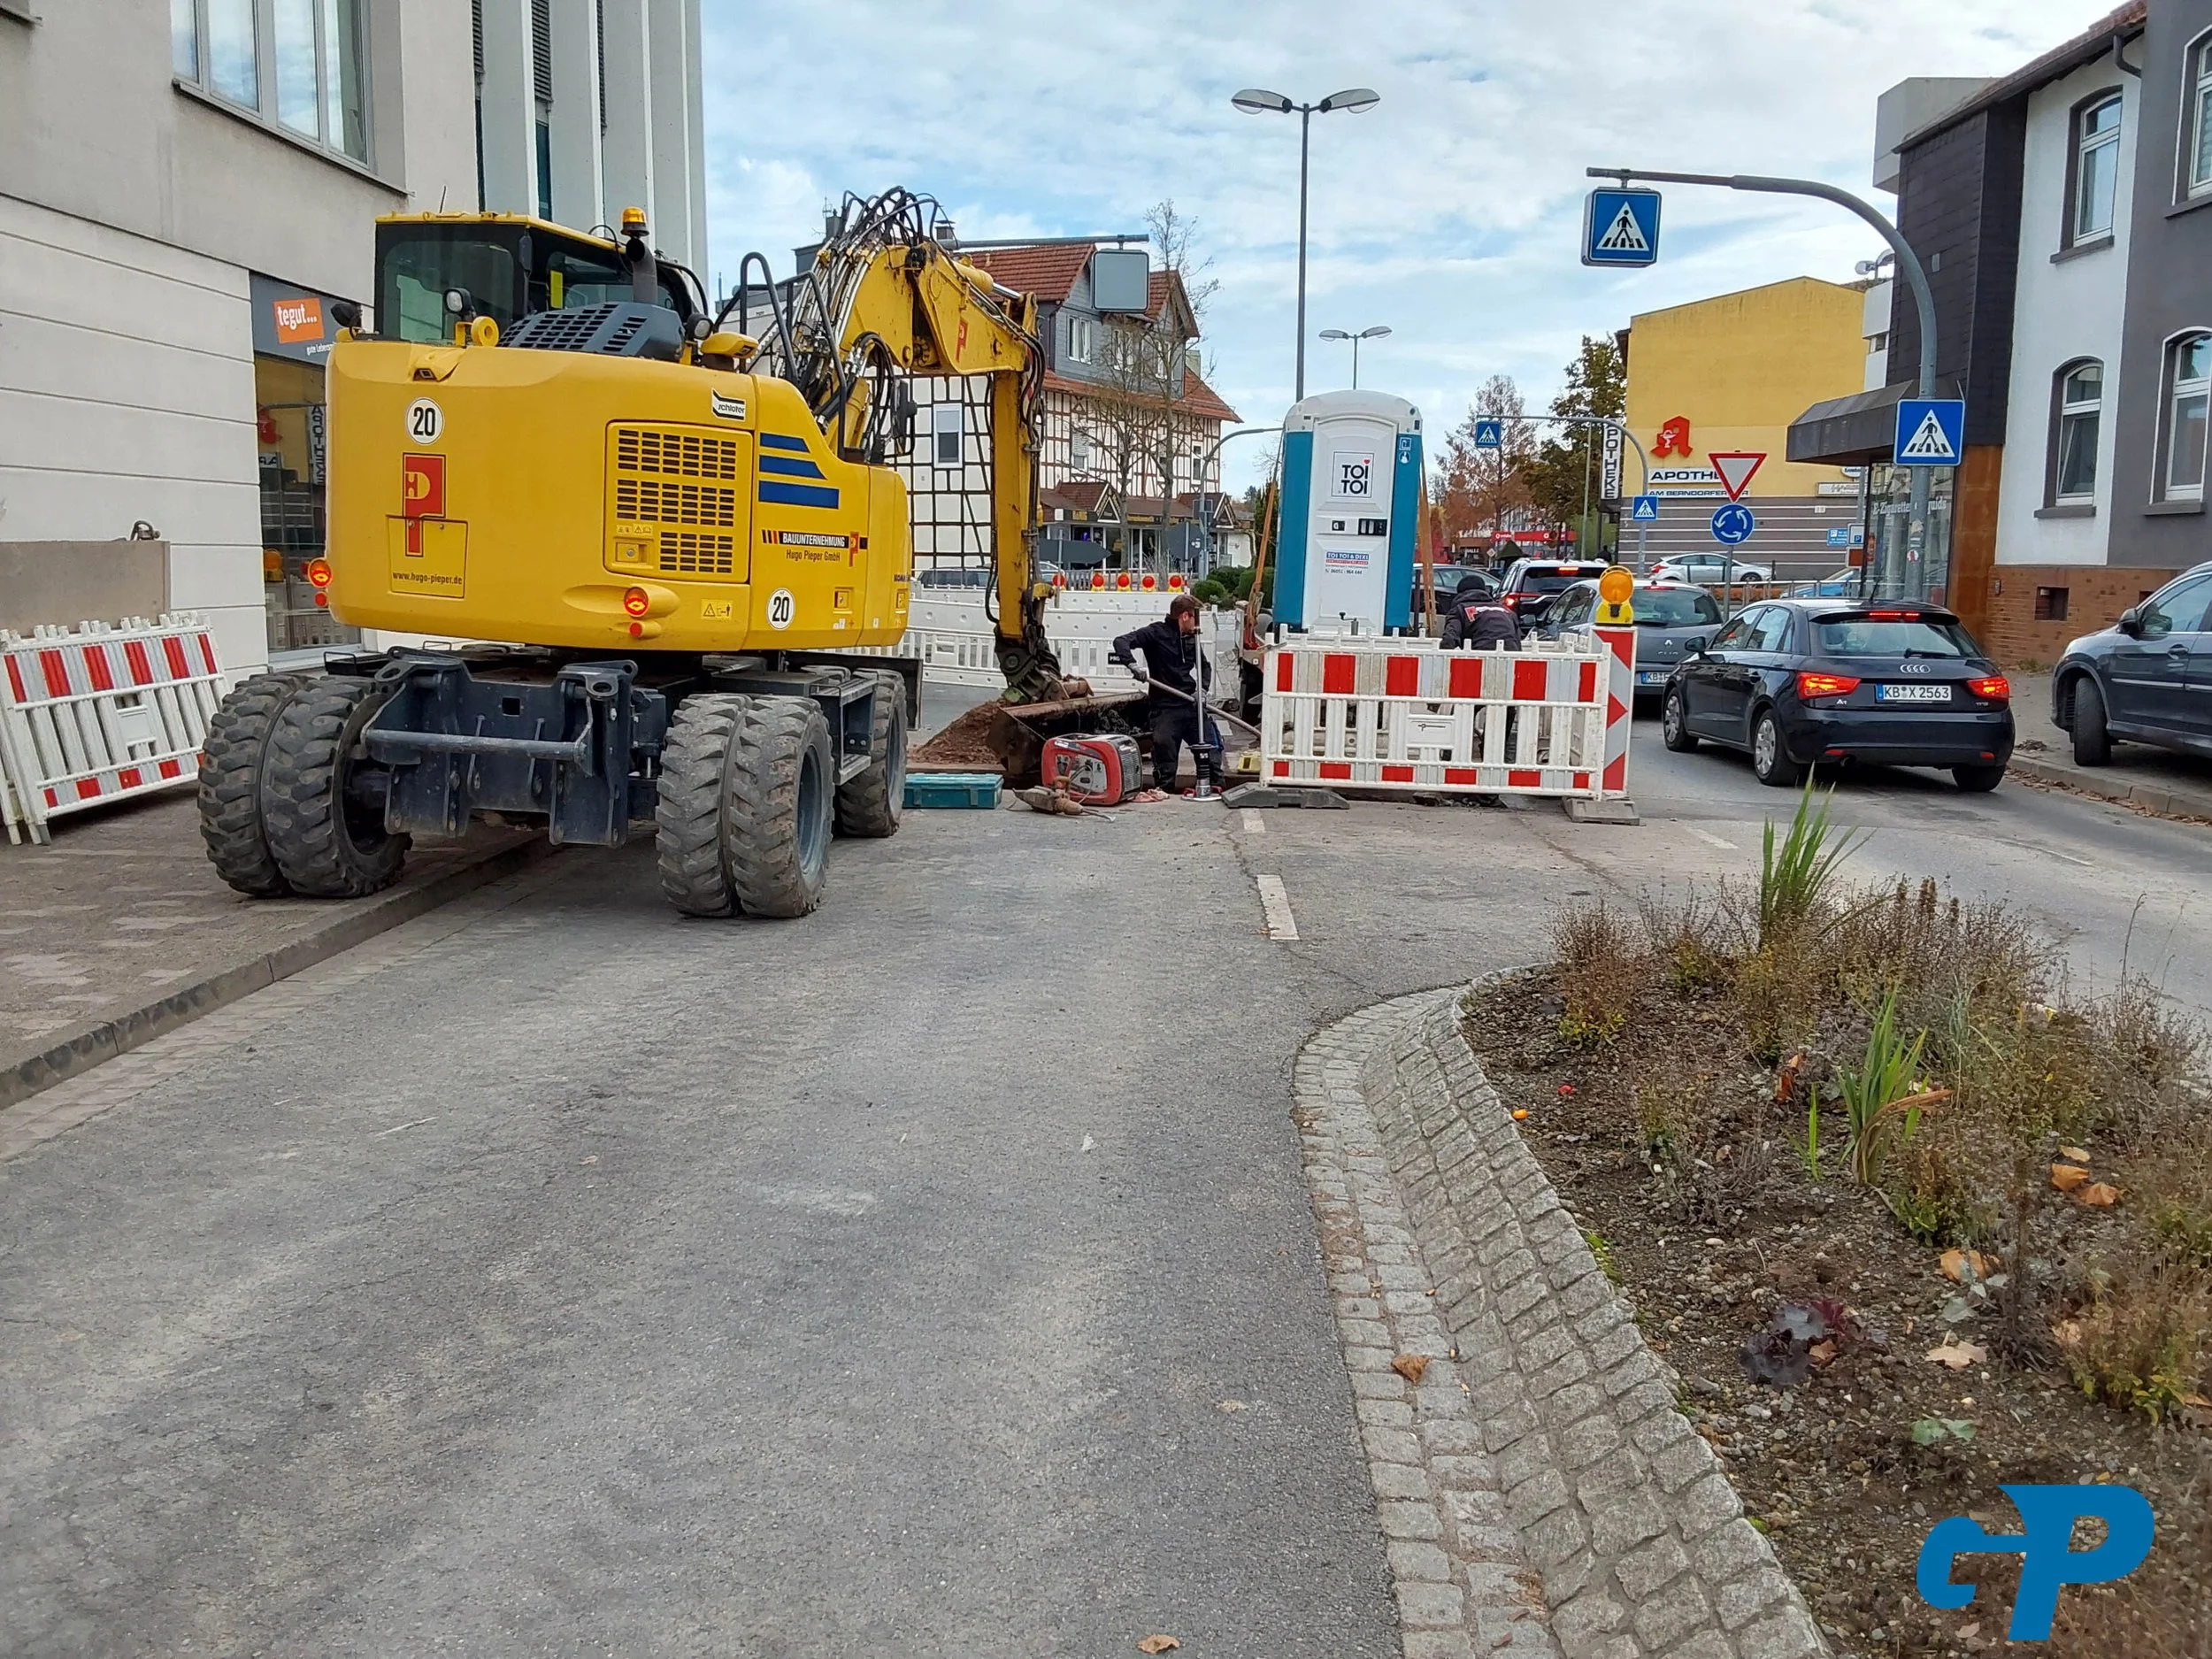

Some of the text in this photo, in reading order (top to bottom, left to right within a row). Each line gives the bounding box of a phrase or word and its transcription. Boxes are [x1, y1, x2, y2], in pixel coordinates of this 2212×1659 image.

[413, 407, 435, 436] 20
[1342, 465, 1369, 479] TOI
[1650, 471, 1719, 480] APOTH
[1341, 480, 1368, 494] TOI
[782, 533, 845, 547] BAUUNTERNEHMUNG
[786, 549, 841, 562] Hugo Pieper GmbH
[392, 572, 463, 585] www.hugo-pieper.de
[772, 595, 791, 622] 20
[1884, 687, 1949, 699] KB X 2563
